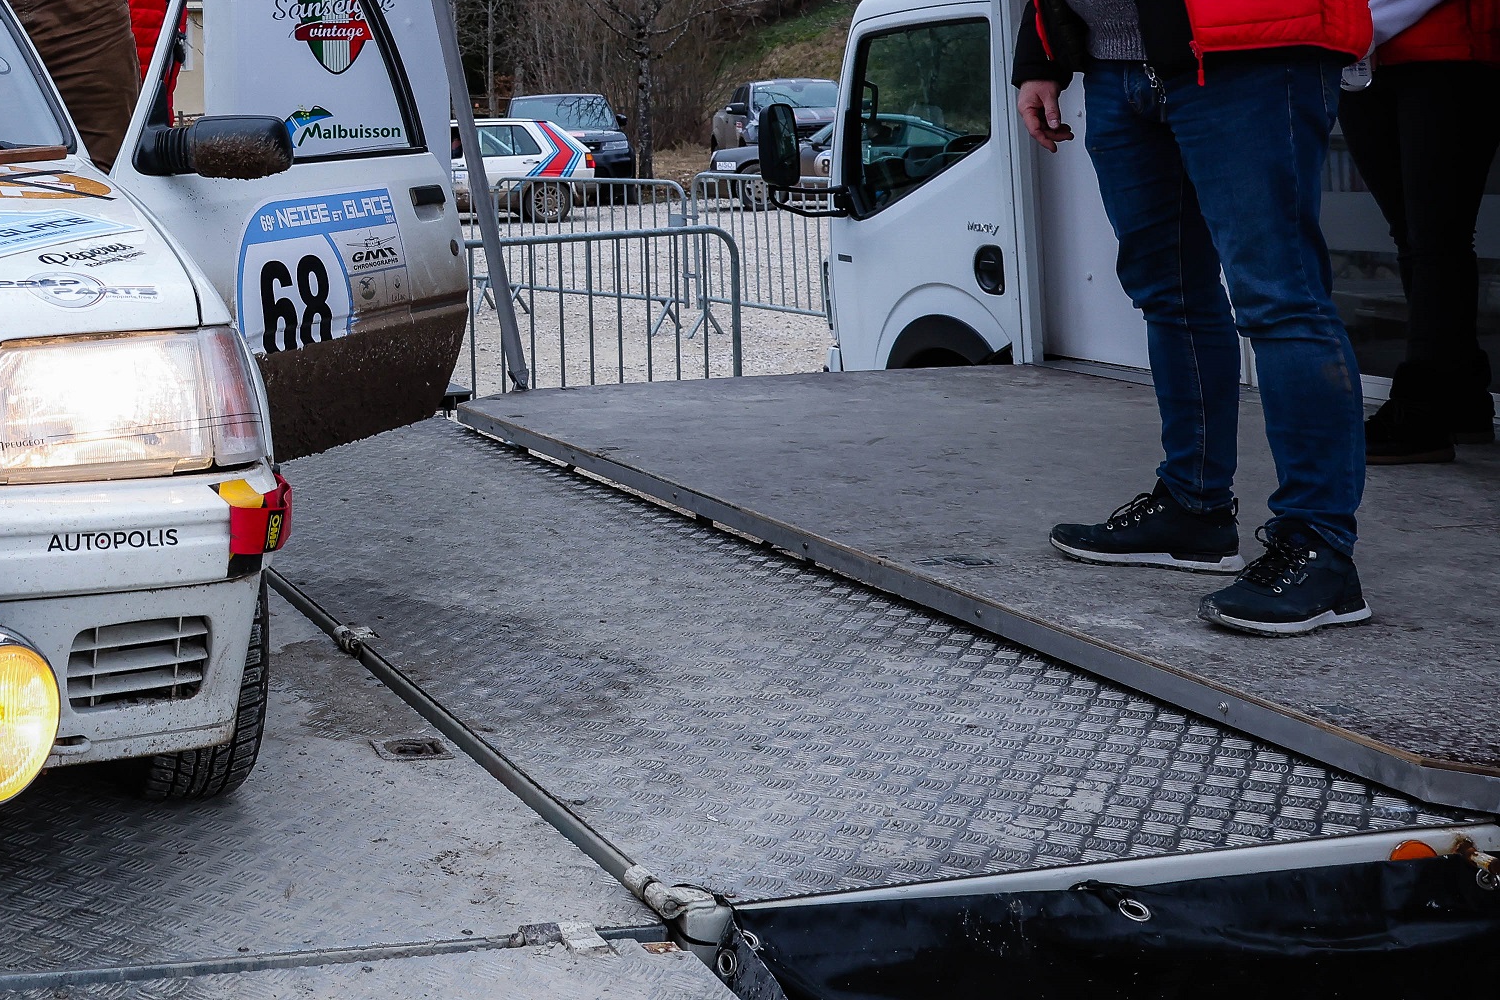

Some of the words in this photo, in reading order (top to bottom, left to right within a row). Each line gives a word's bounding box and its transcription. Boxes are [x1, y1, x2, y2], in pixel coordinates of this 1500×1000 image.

[310, 25, 364, 41] vintage
[298, 123, 400, 146] Malbuisson
[276, 204, 330, 228] NEIGE
[333, 210, 344, 222] ET
[342, 196, 392, 220] GLACE
[967, 221, 1000, 236] Maxity
[352, 247, 398, 262] GMT
[354, 258, 398, 270] CHRONOGRAPHS
[54, 287, 158, 296] PARTS
[260, 254, 332, 354] 68
[5, 439, 44, 448] PEUGEOT
[269, 514, 280, 548] OMP
[48, 528, 178, 552] AUTOPOLIS
